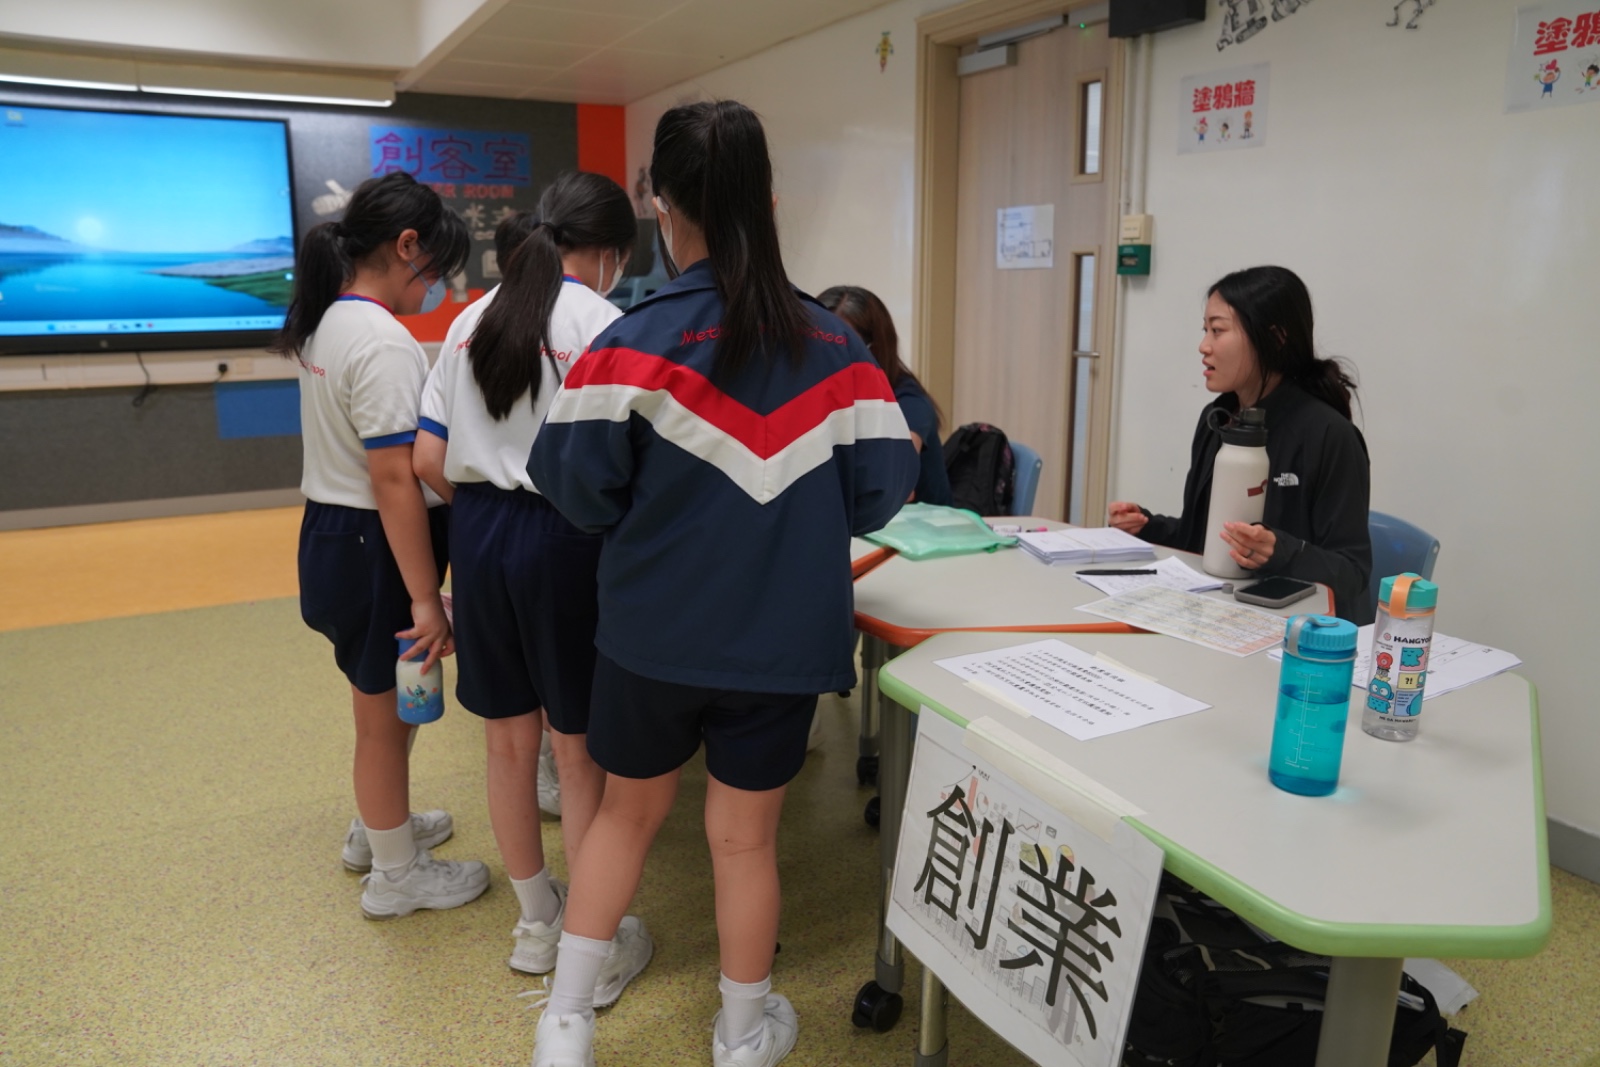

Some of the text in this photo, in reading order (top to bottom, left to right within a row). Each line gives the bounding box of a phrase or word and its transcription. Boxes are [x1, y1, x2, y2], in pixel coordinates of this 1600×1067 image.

[373, 131, 531, 181] 創客室
[914, 785, 1121, 1039] 創業
